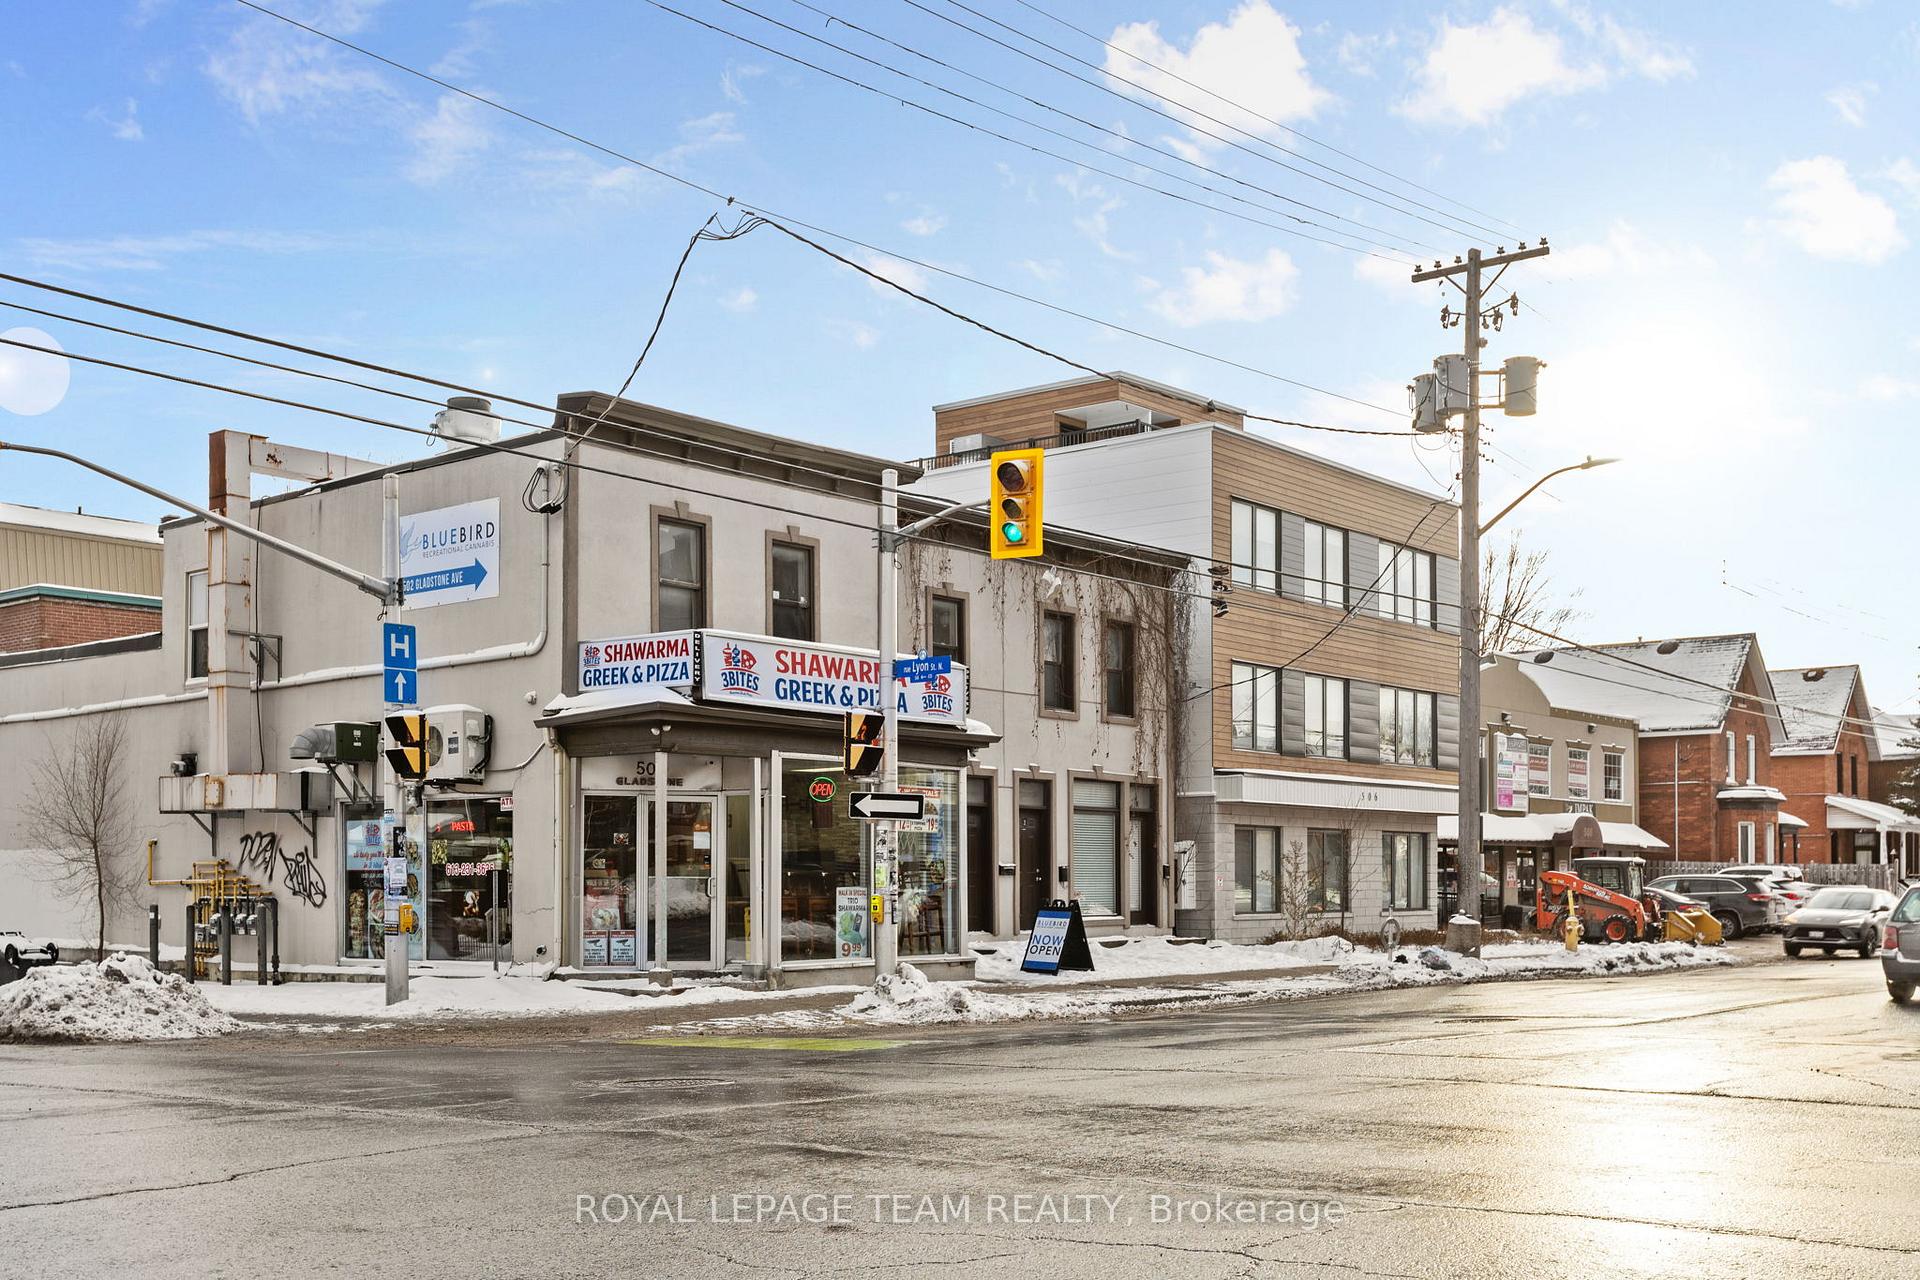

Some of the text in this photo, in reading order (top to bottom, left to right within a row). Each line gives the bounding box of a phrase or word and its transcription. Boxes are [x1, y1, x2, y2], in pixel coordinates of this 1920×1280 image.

[422, 522, 495, 550] BLUEBIRD
[423, 540, 495, 558] RECREATIONAL CANNABIS
[415, 574, 450, 589] GLADSTONE
[451, 571, 464, 584] AVE
[390, 633, 410, 658] H
[604, 638, 690, 663] SHAWARMA
[582, 661, 689, 687] GREEK & PIZZA
[774, 649, 908, 688] SHAWAR
[912, 661, 929, 674] Lyon
[720, 671, 760, 692] 3BITES
[774, 677, 908, 713] GREEK & PIA
[921, 694, 953, 712] 3BITES
[616, 777, 684, 787] GLADSNE
[812, 783, 833, 796] OPEN
[838, 904, 866, 912] SHAWARMA
[1032, 934, 1064, 946] NOW
[1029, 945, 1061, 956] OPEN
